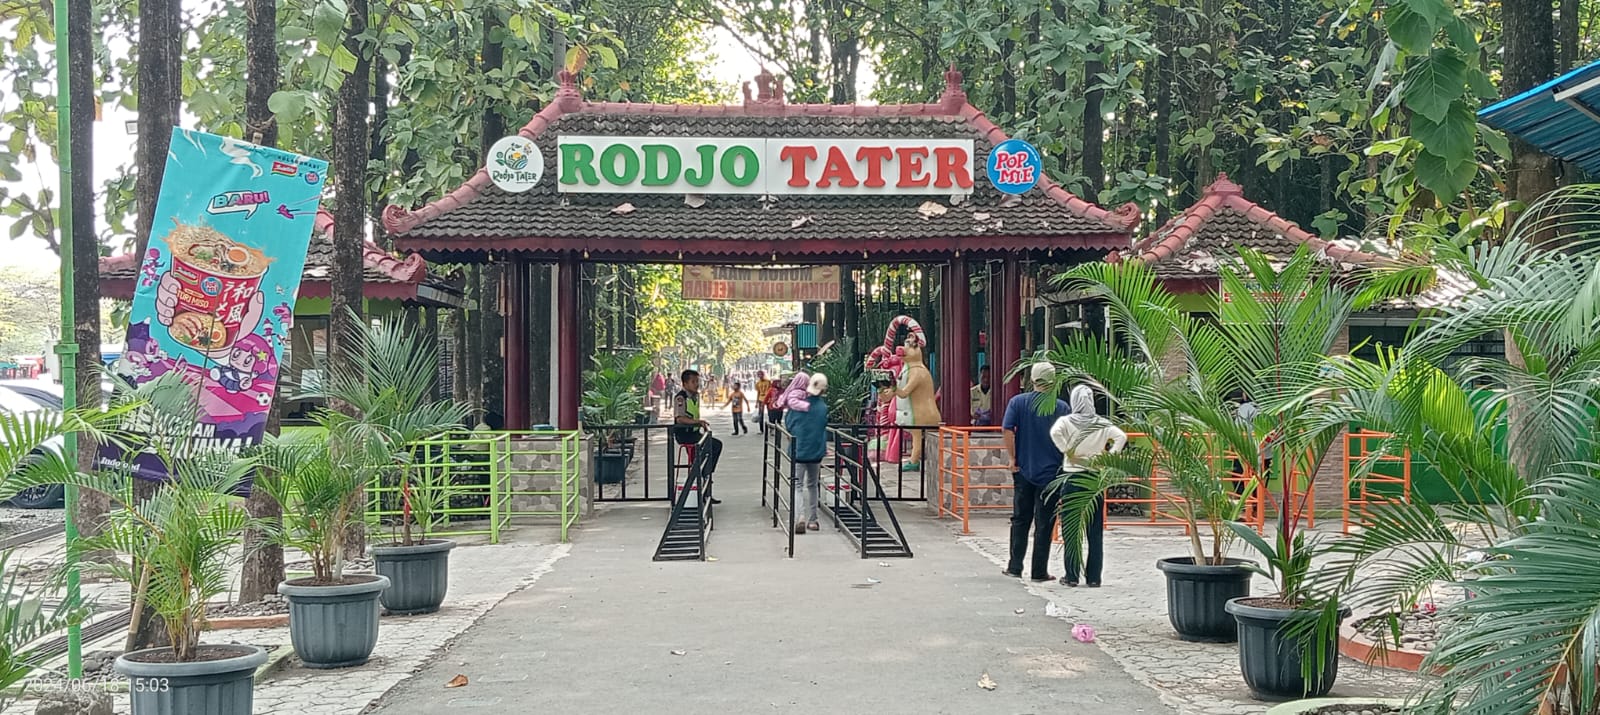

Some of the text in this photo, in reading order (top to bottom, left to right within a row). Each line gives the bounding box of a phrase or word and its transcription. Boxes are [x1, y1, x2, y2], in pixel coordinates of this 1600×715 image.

[559, 143, 974, 189] RODJO TATER
[995, 152, 1028, 170] POP
[999, 166, 1033, 184] MIE
[213, 190, 270, 209] BARU!
[191, 297, 209, 308] MISO
[100, 457, 140, 471] Indood
